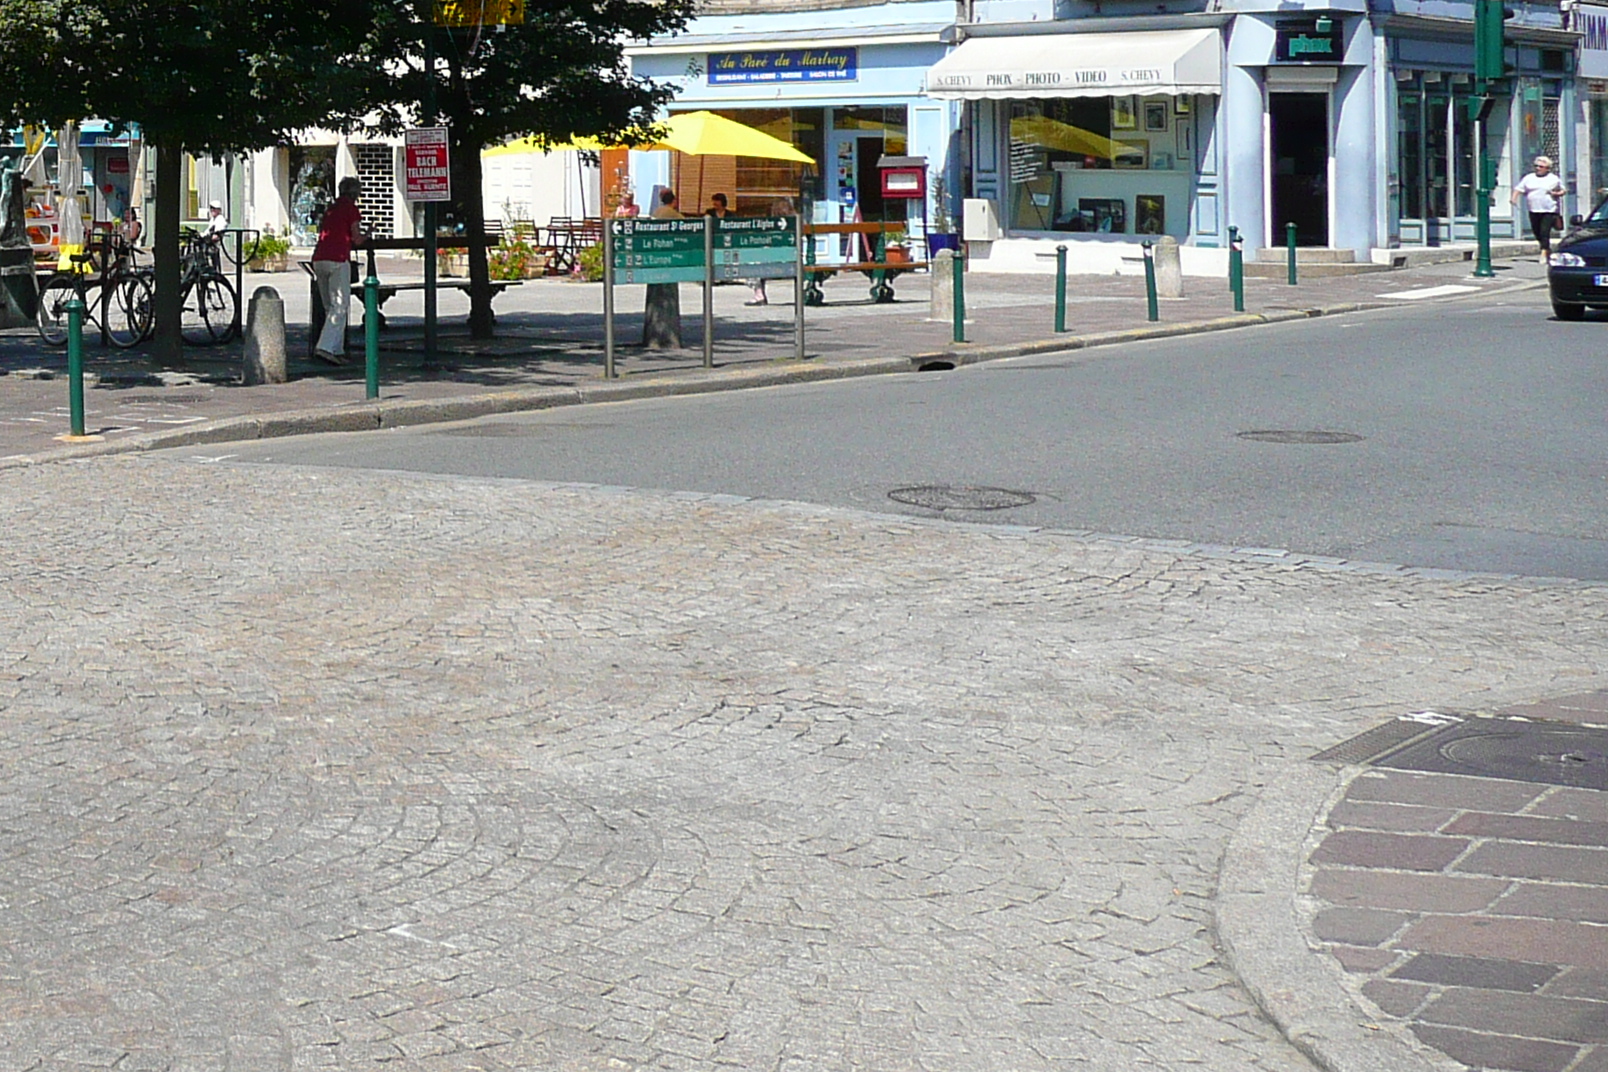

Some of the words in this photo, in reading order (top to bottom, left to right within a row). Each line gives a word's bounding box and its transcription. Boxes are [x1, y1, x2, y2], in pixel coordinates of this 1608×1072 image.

[1288, 33, 1333, 57] phox
[716, 54, 736, 69] Au
[739, 53, 769, 69] Pavé
[774, 52, 790, 67] du
[797, 51, 848, 69] Martray
[944, 75, 973, 86] CHEVY
[986, 74, 1013, 86] PHOX
[1025, 72, 1061, 84] PHOTO
[1075, 70, 1107, 83] VIDEO
[1129, 69, 1162, 81] CHEVY
[416, 157, 437, 166] BACH
[635, 221, 670, 231] Restaurant
[679, 221, 704, 232] Georges
[720, 219, 751, 229] Restaurant
